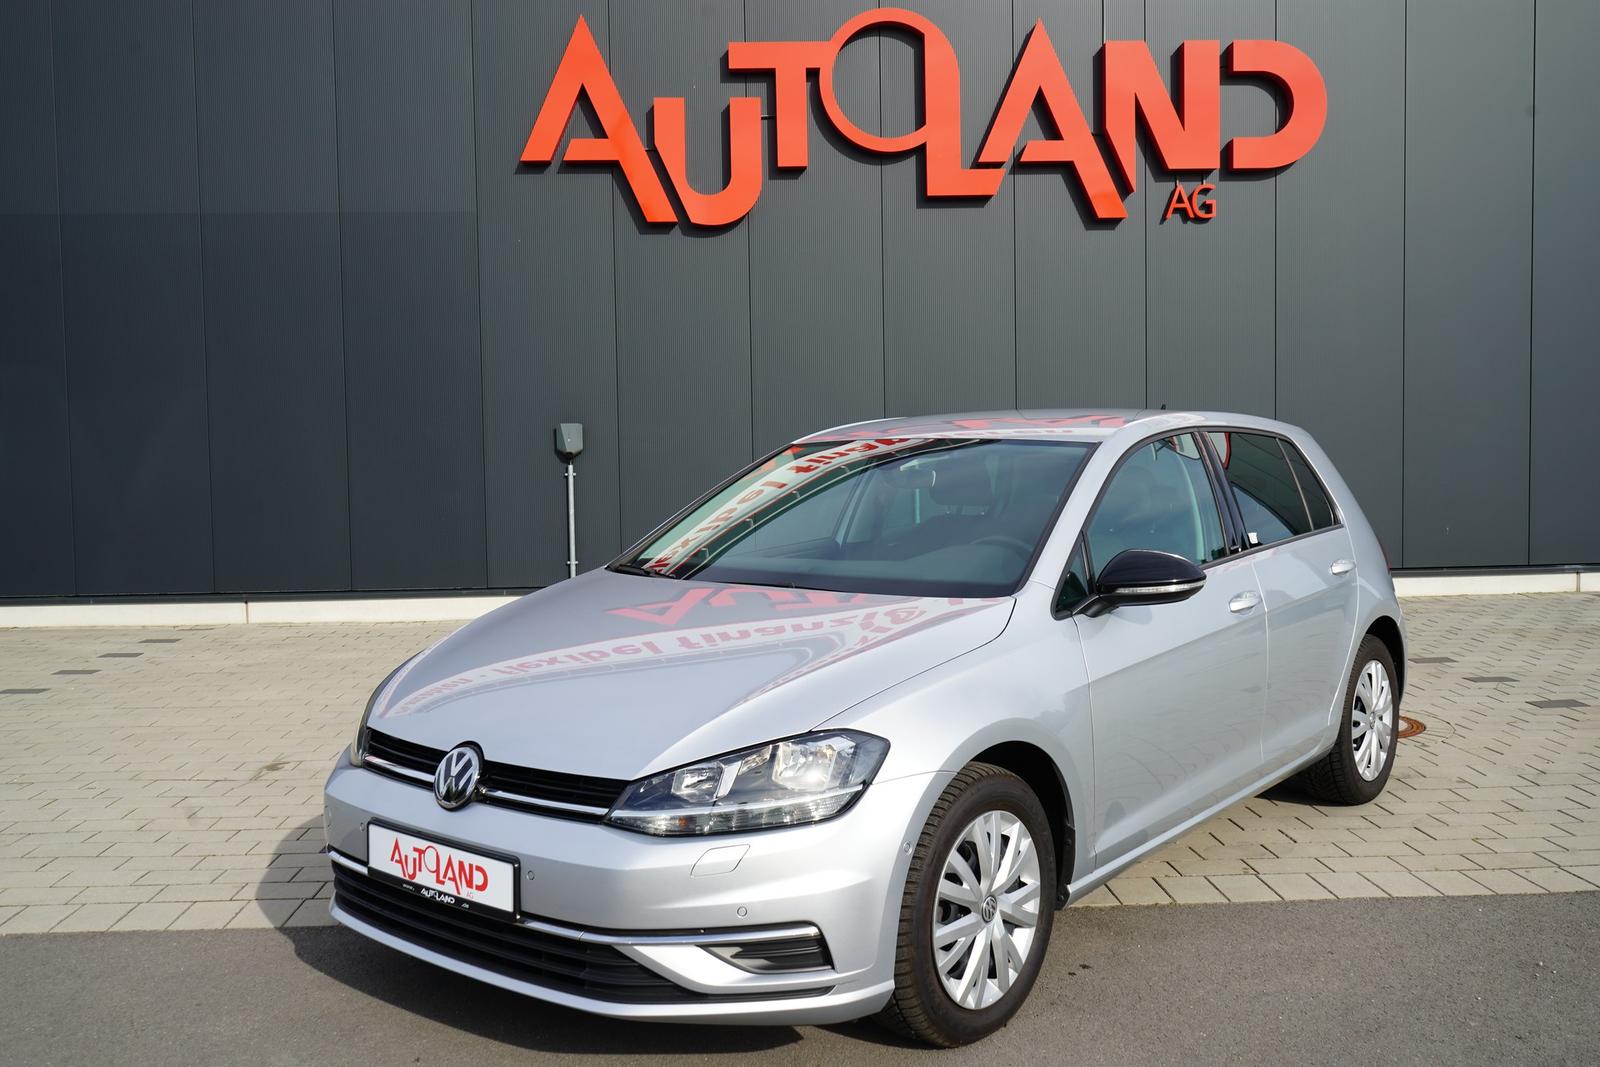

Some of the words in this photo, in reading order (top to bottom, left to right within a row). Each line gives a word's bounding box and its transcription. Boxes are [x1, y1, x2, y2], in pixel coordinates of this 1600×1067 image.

[520, 8, 1328, 226] AUTOLAND
[1166, 183, 1217, 219] AG
[390, 837, 489, 895] AUTOLAND
